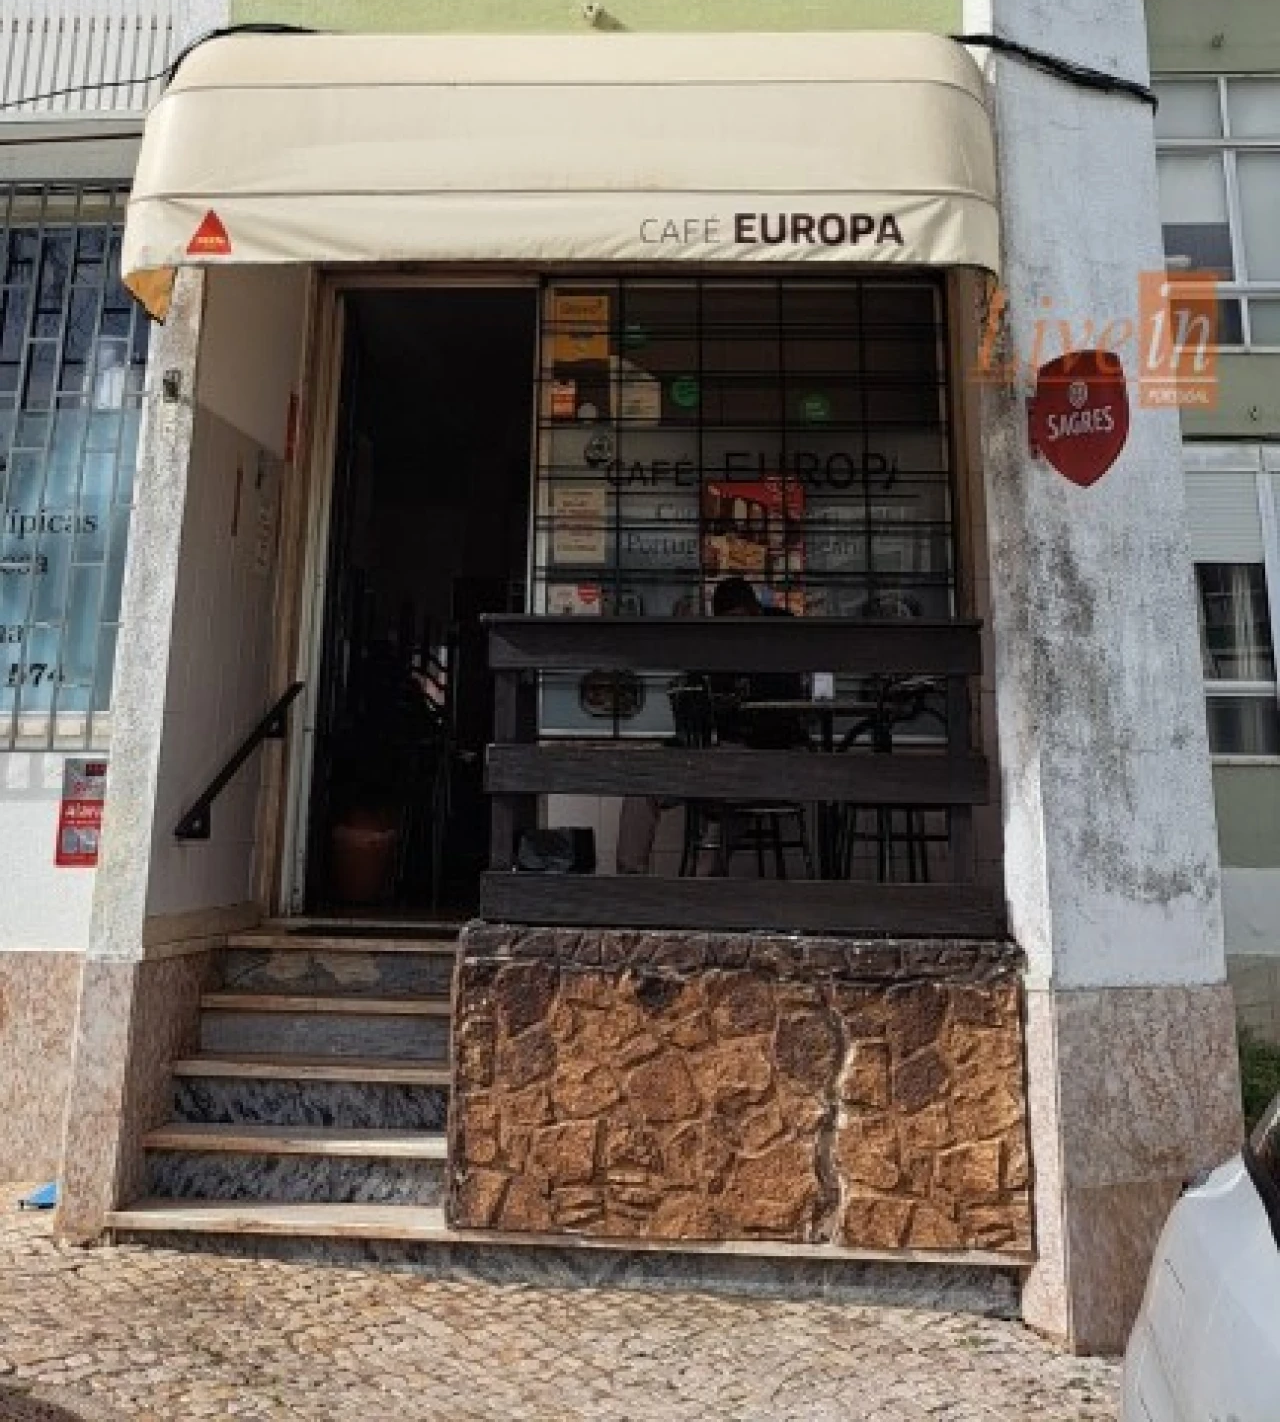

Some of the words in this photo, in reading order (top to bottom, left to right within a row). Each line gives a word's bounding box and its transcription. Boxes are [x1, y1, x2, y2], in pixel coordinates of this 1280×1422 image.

[639, 214, 721, 244] CAFÉ
[734, 212, 905, 246] EUROPA
[1047, 405, 1114, 441] SAGRES
[607, 453, 694, 487] CAFÉ
